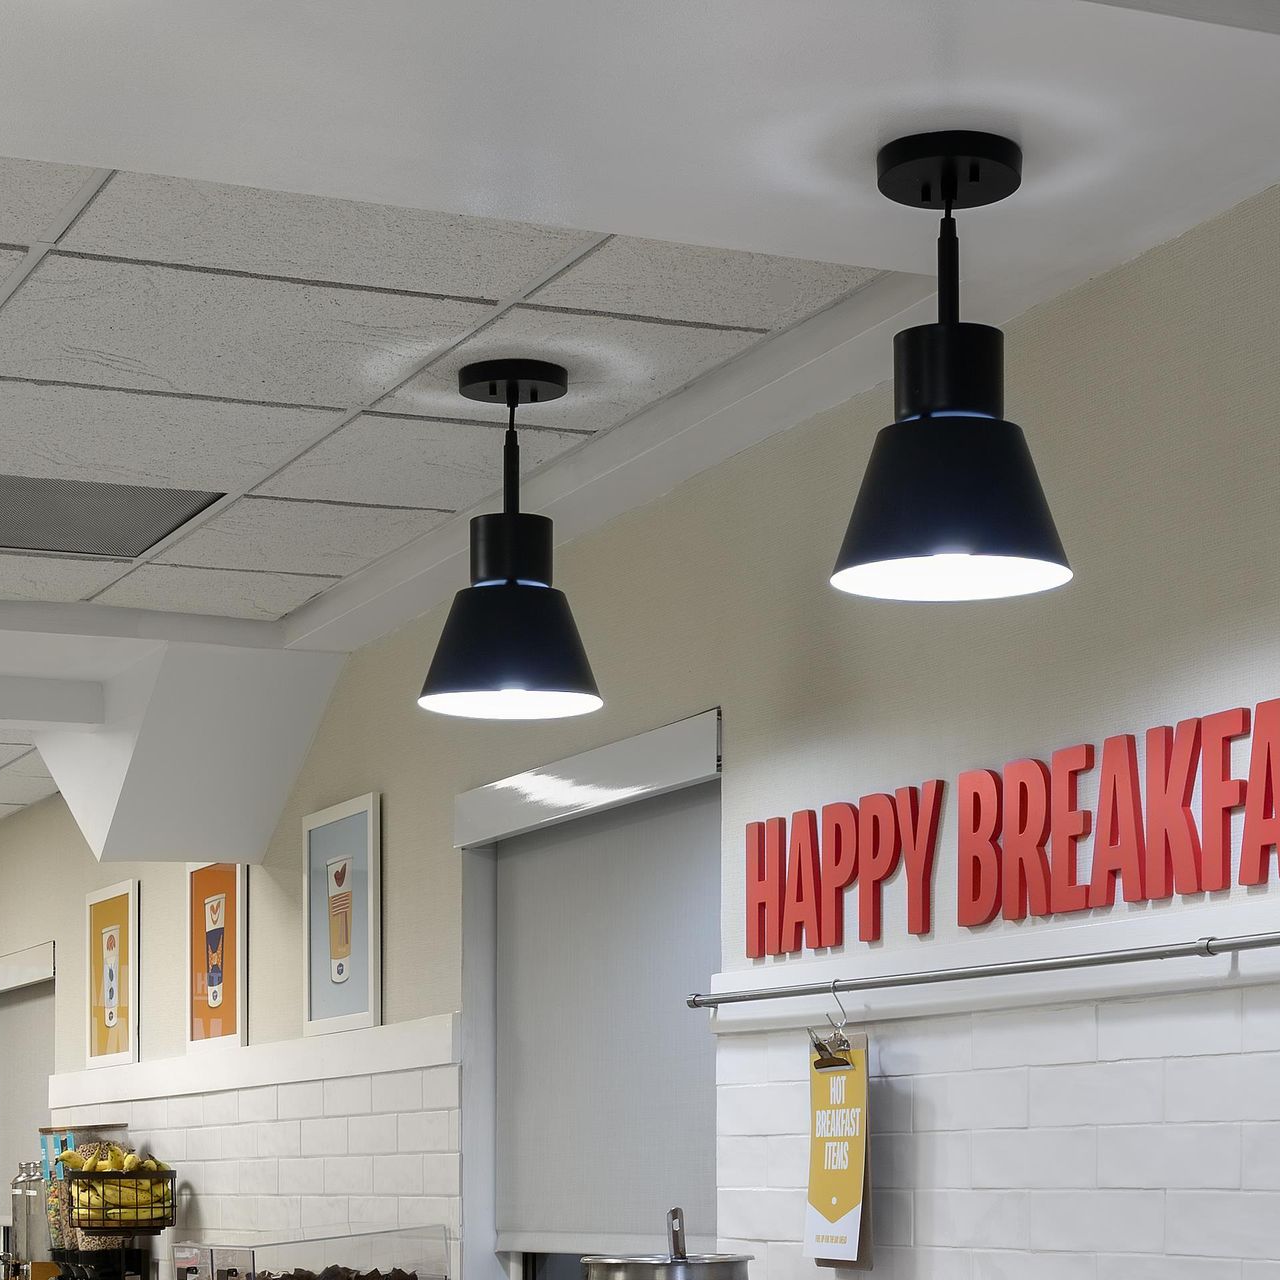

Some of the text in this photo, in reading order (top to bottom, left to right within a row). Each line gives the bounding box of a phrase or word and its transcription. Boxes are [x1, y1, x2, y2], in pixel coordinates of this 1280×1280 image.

[746, 780, 945, 958] HAPPY
[830, 1075, 847, 1104] HOT
[815, 1108, 861, 1138] BREAKFAST
[824, 1141, 849, 1170] ITEMS
